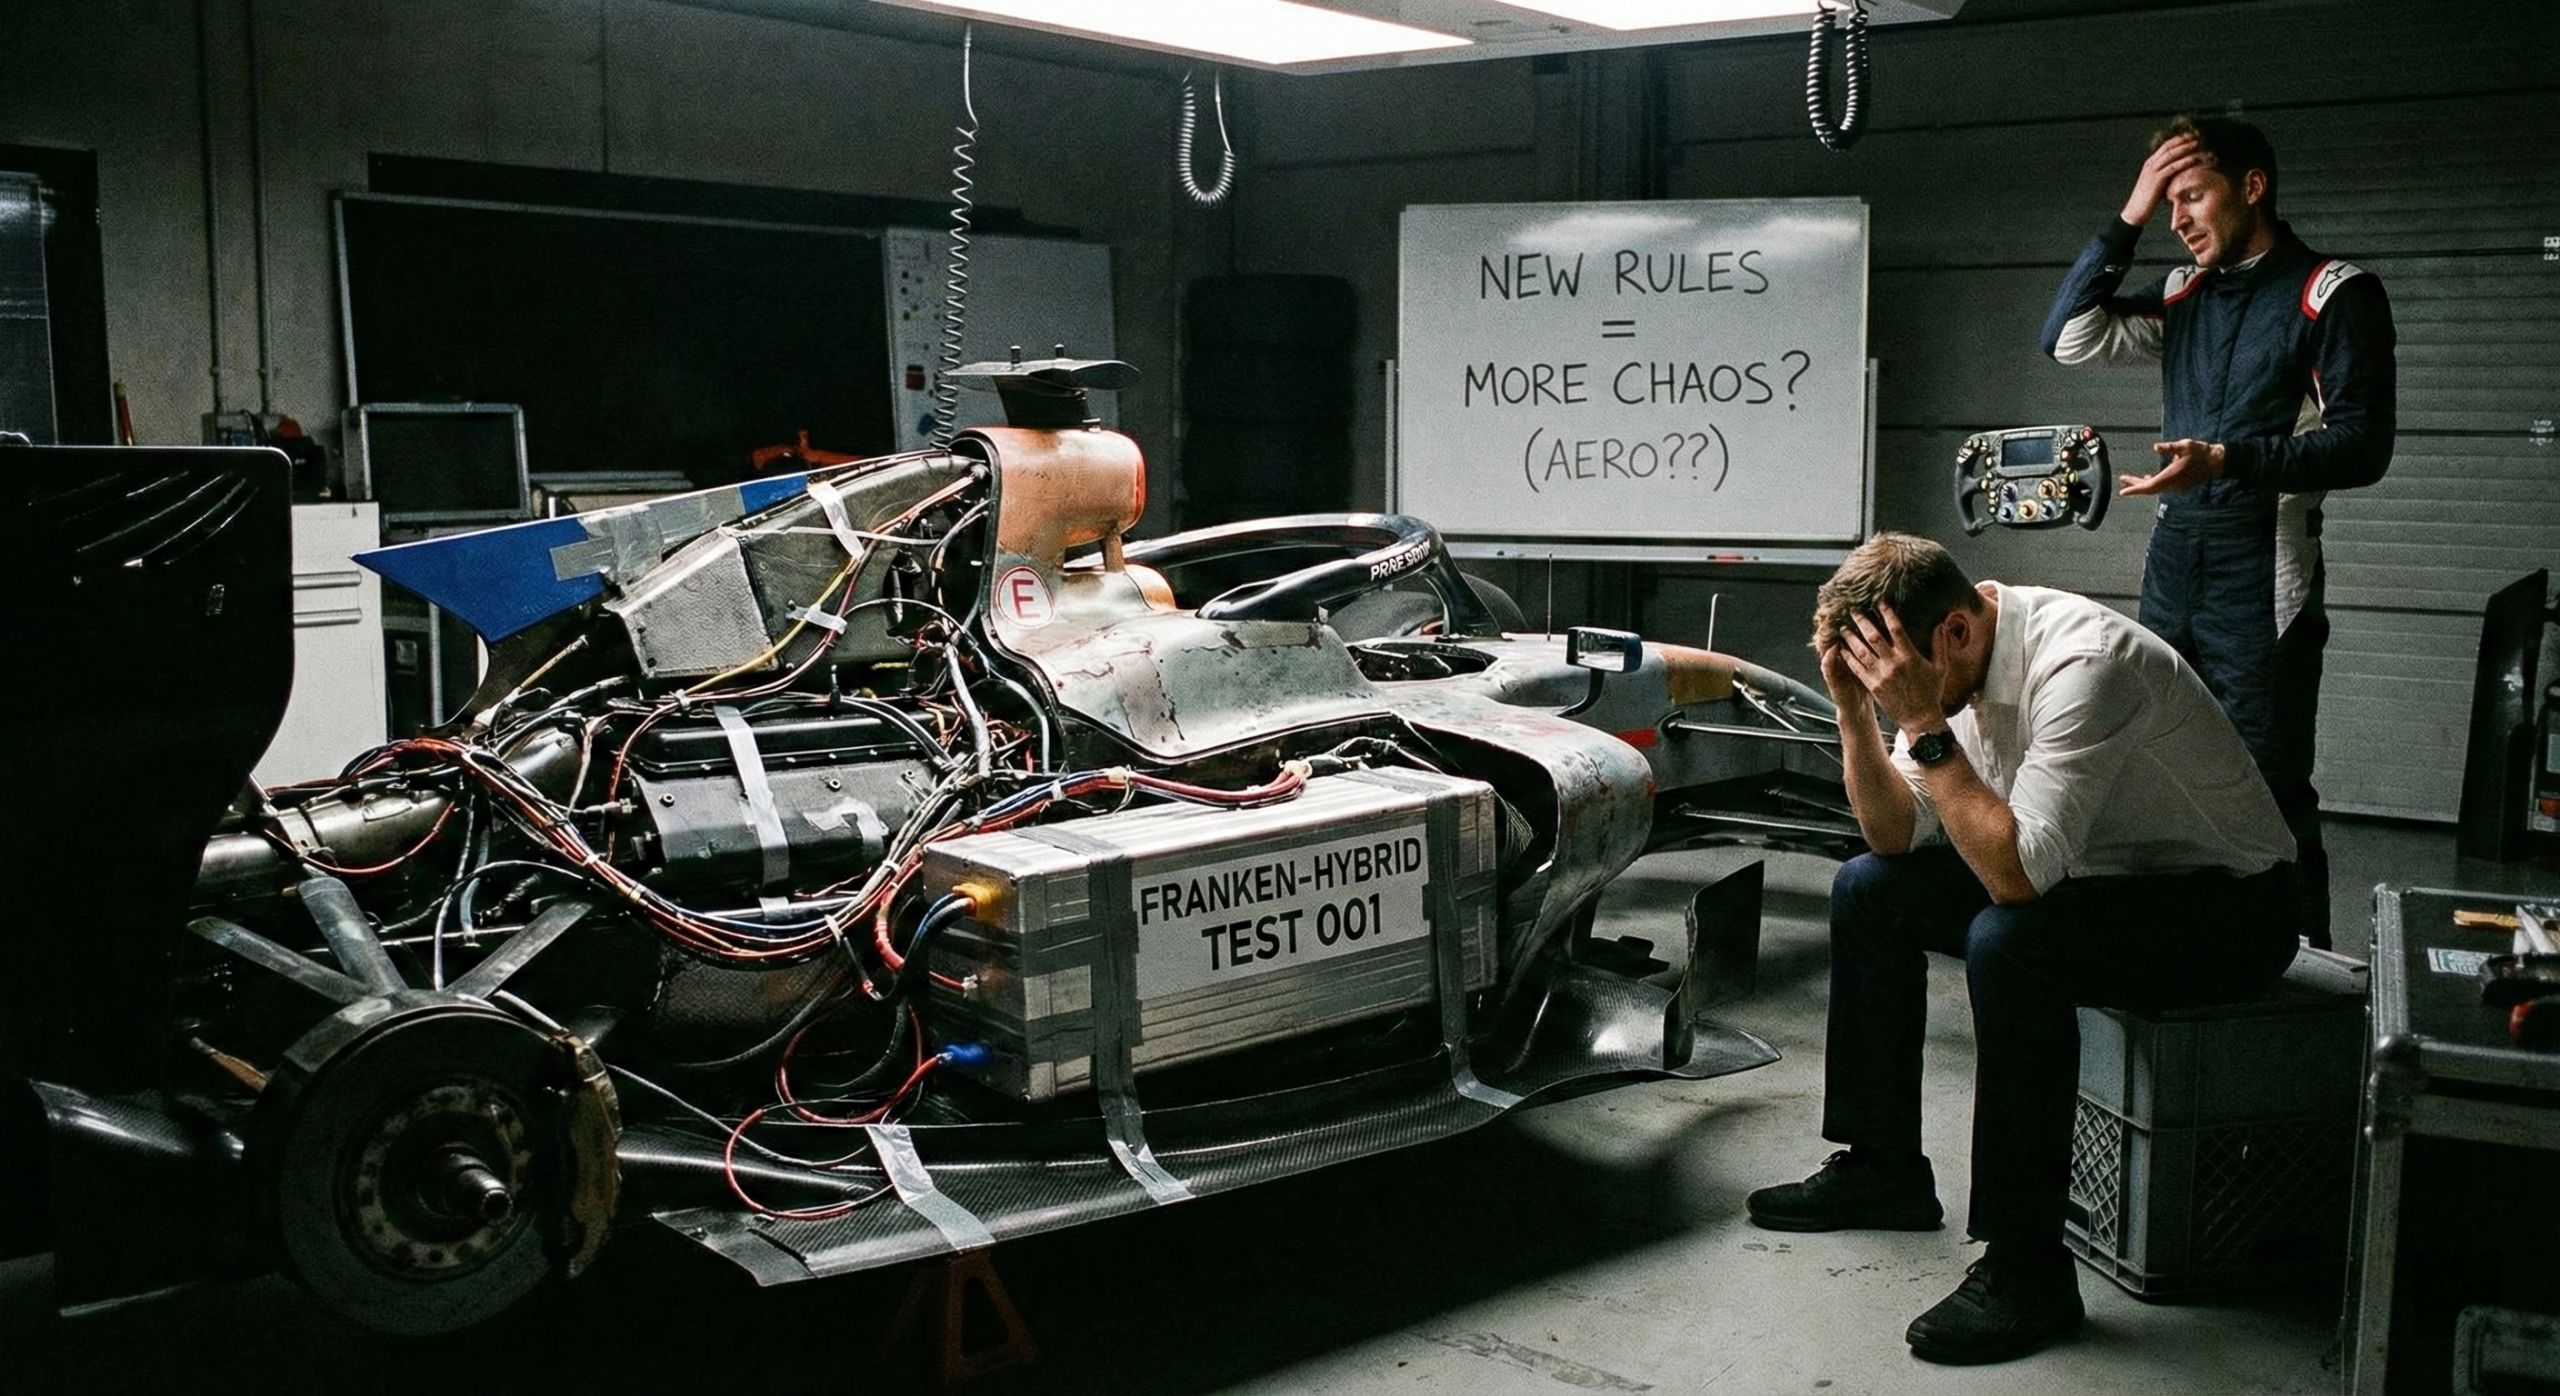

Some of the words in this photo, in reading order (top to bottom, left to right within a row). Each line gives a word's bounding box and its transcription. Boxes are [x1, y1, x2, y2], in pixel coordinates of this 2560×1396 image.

[1480, 252, 1584, 301] NEW
[1614, 249, 1770, 296] RULES
[1601, 319, 1636, 339] =
[1464, 361, 1588, 408] MORE
[1612, 349, 1811, 412] CHAOS?
[1524, 423, 1730, 494] (AERO??)
[1012, 579, 1040, 618] E
[1140, 837, 1421, 926] FRANKEN-HYBRID
[1201, 909, 1304, 971] TEST
[1316, 892, 1381, 947] 001
